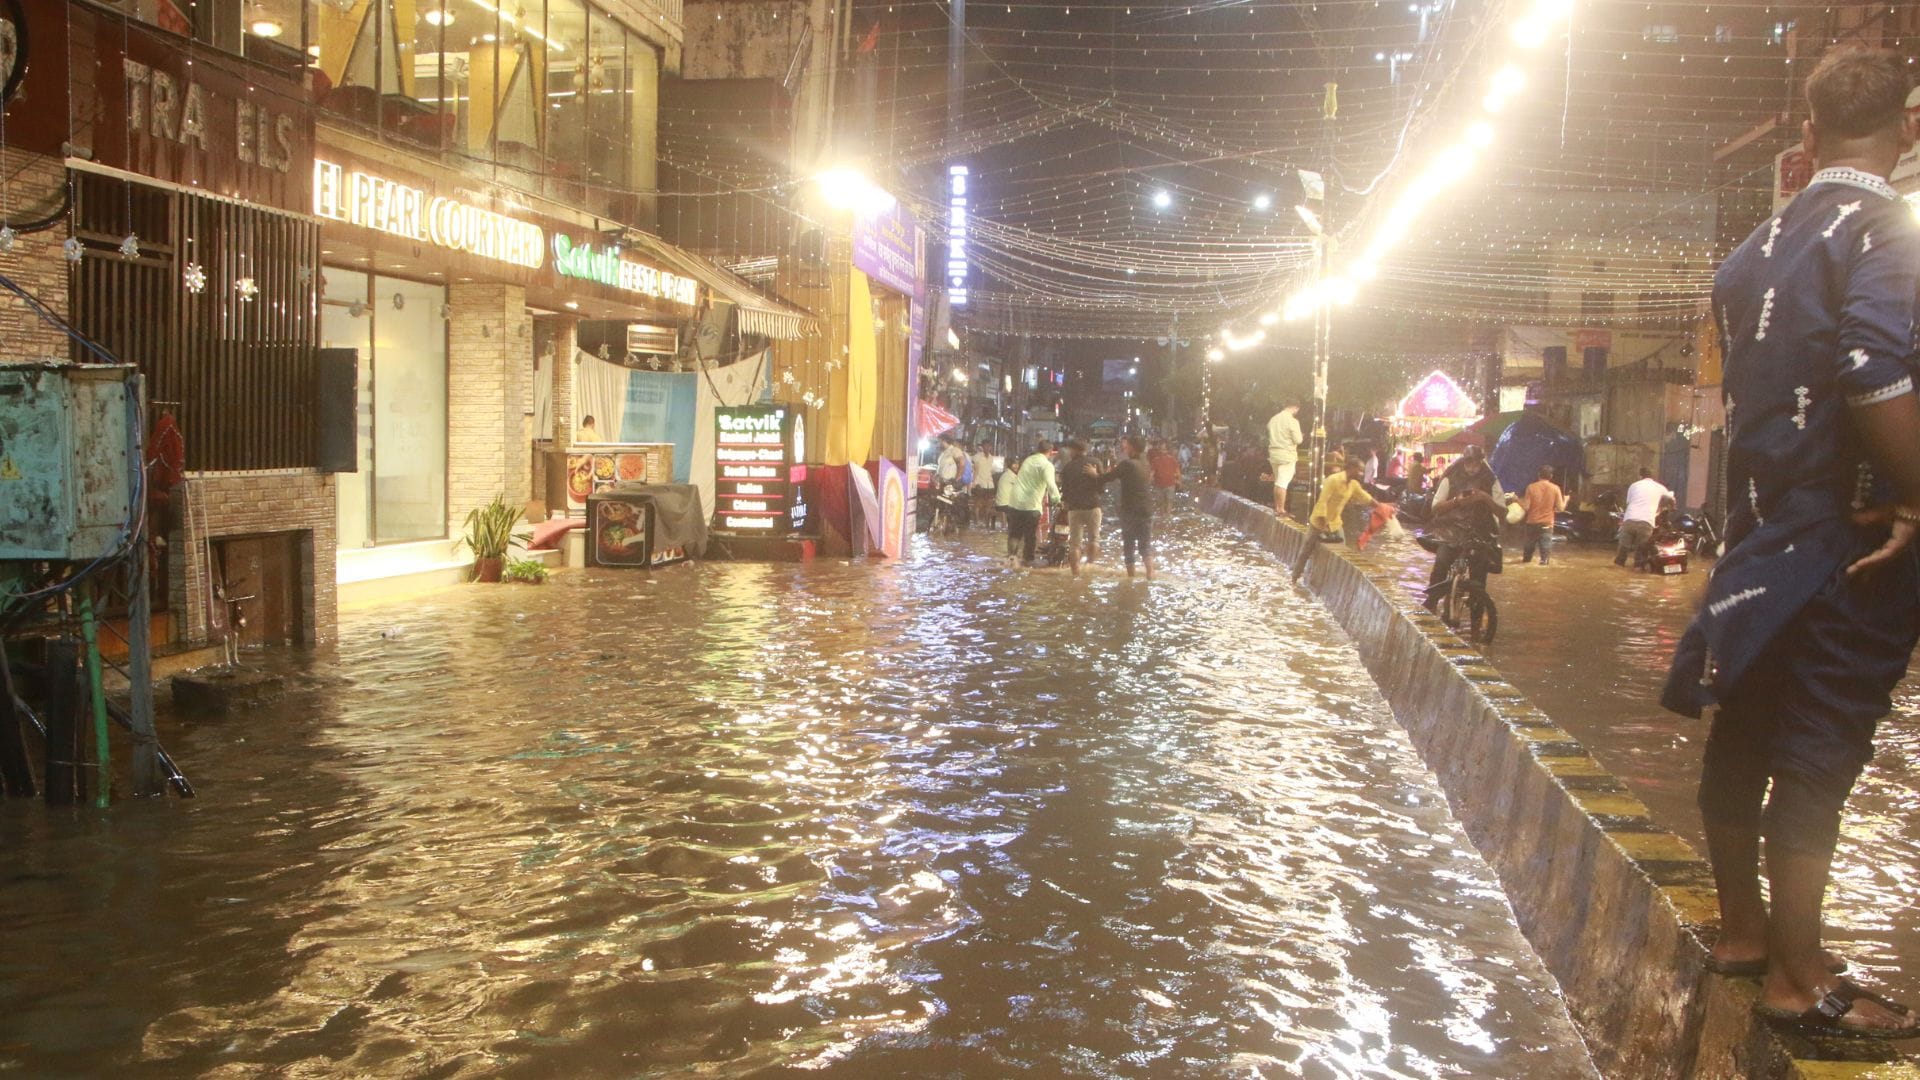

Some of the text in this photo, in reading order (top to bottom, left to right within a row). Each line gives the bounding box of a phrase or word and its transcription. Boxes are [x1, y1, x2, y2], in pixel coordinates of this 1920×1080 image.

[314, 159, 544, 269] EL PEARL COURTYARD
[620, 260, 697, 305] RESTAURANT
[719, 415, 780, 430] Satvik
